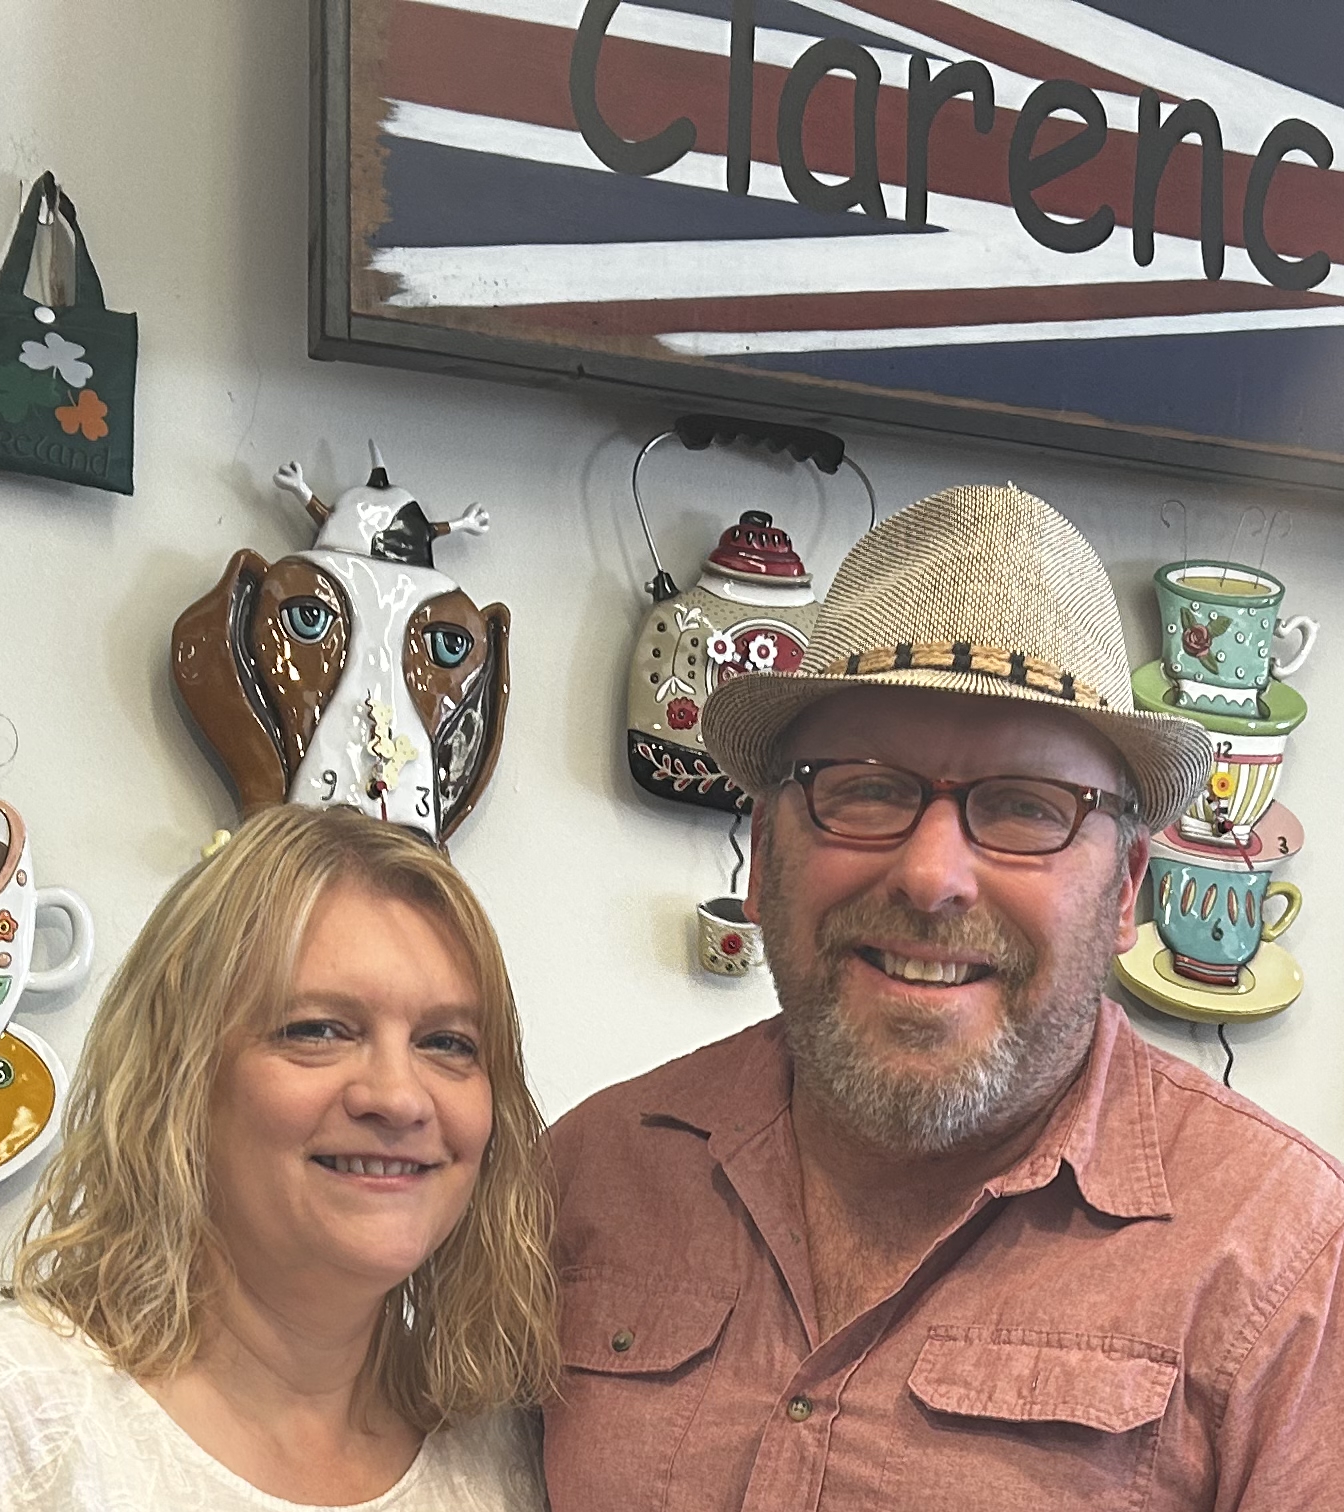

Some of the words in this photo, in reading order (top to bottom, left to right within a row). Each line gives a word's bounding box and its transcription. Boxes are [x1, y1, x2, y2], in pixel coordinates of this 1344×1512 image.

[1215, 740, 1233, 760] 12
[321, 770, 338, 801] 9
[415, 786, 431, 818] 3
[1278, 836, 1290, 855] 3
[1211, 919, 1224, 942] 6
